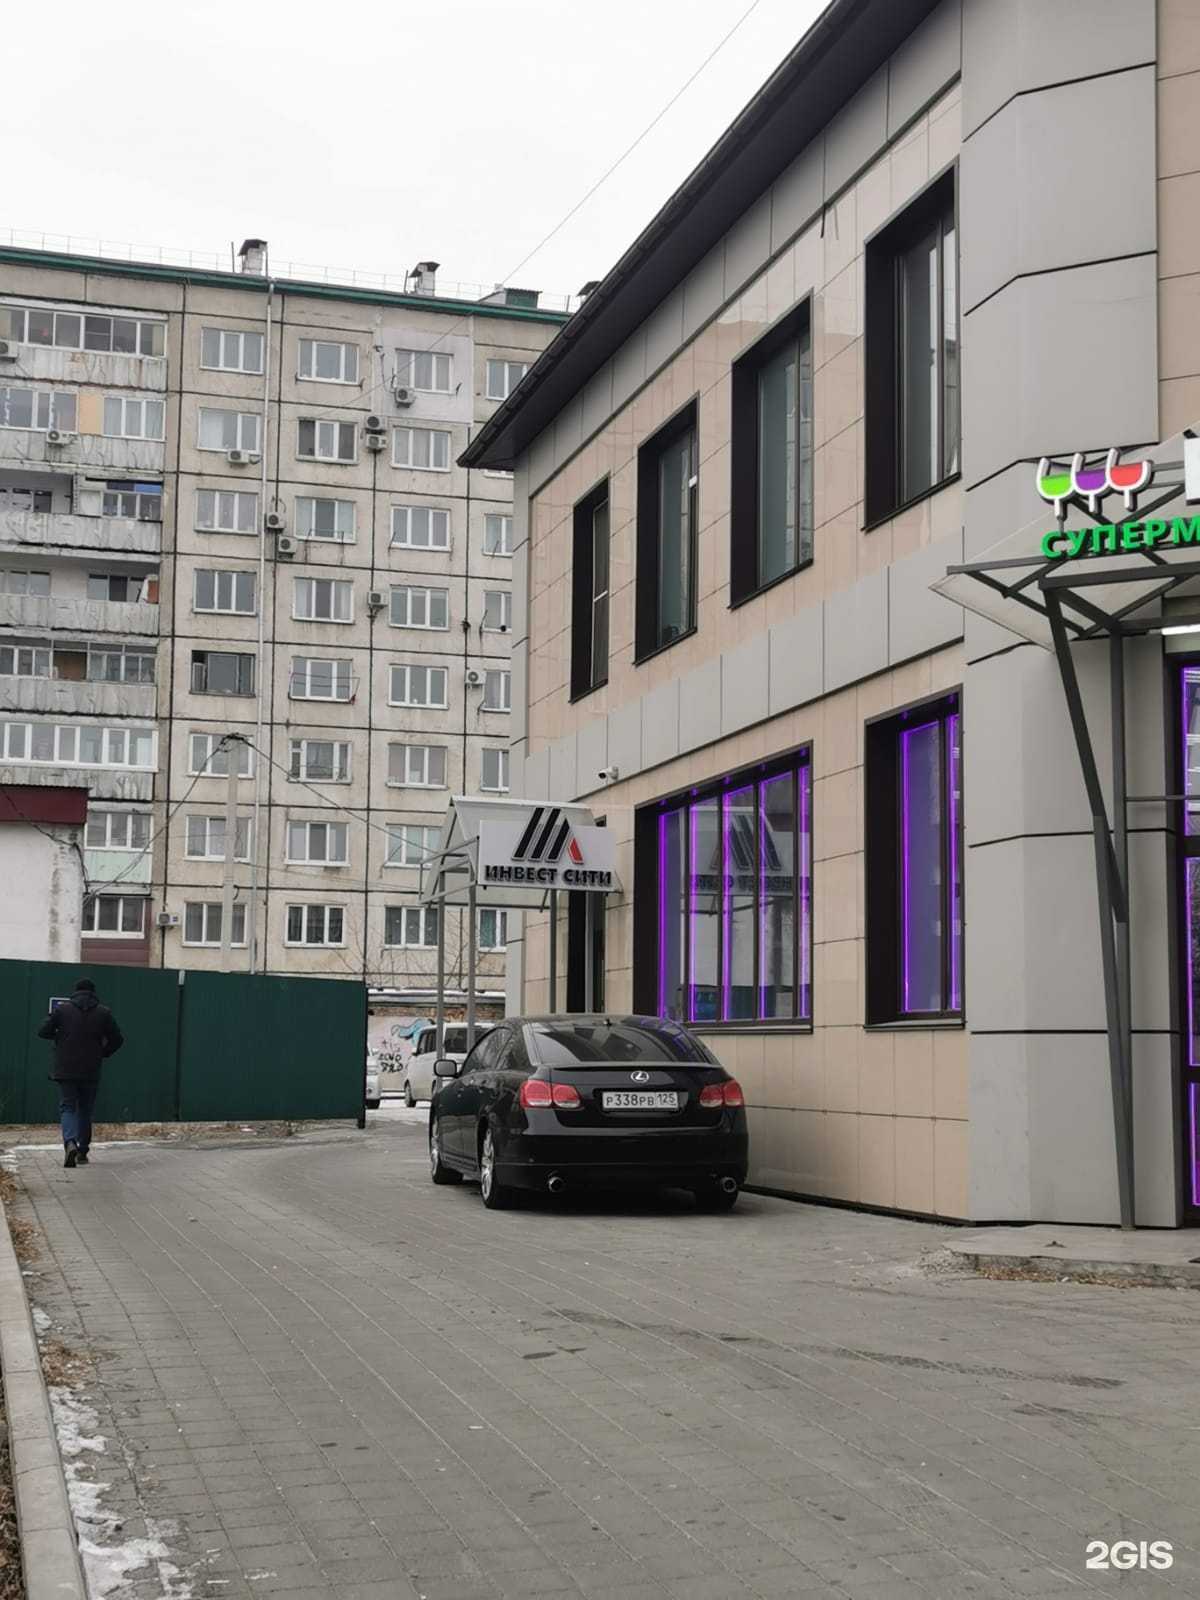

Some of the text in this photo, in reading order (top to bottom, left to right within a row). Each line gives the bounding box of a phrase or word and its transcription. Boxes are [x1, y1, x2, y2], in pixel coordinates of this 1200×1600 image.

[1041, 515, 1200, 558] СУПЕРМ
[485, 865, 612, 885] ИНВЕСТ СИТИ
